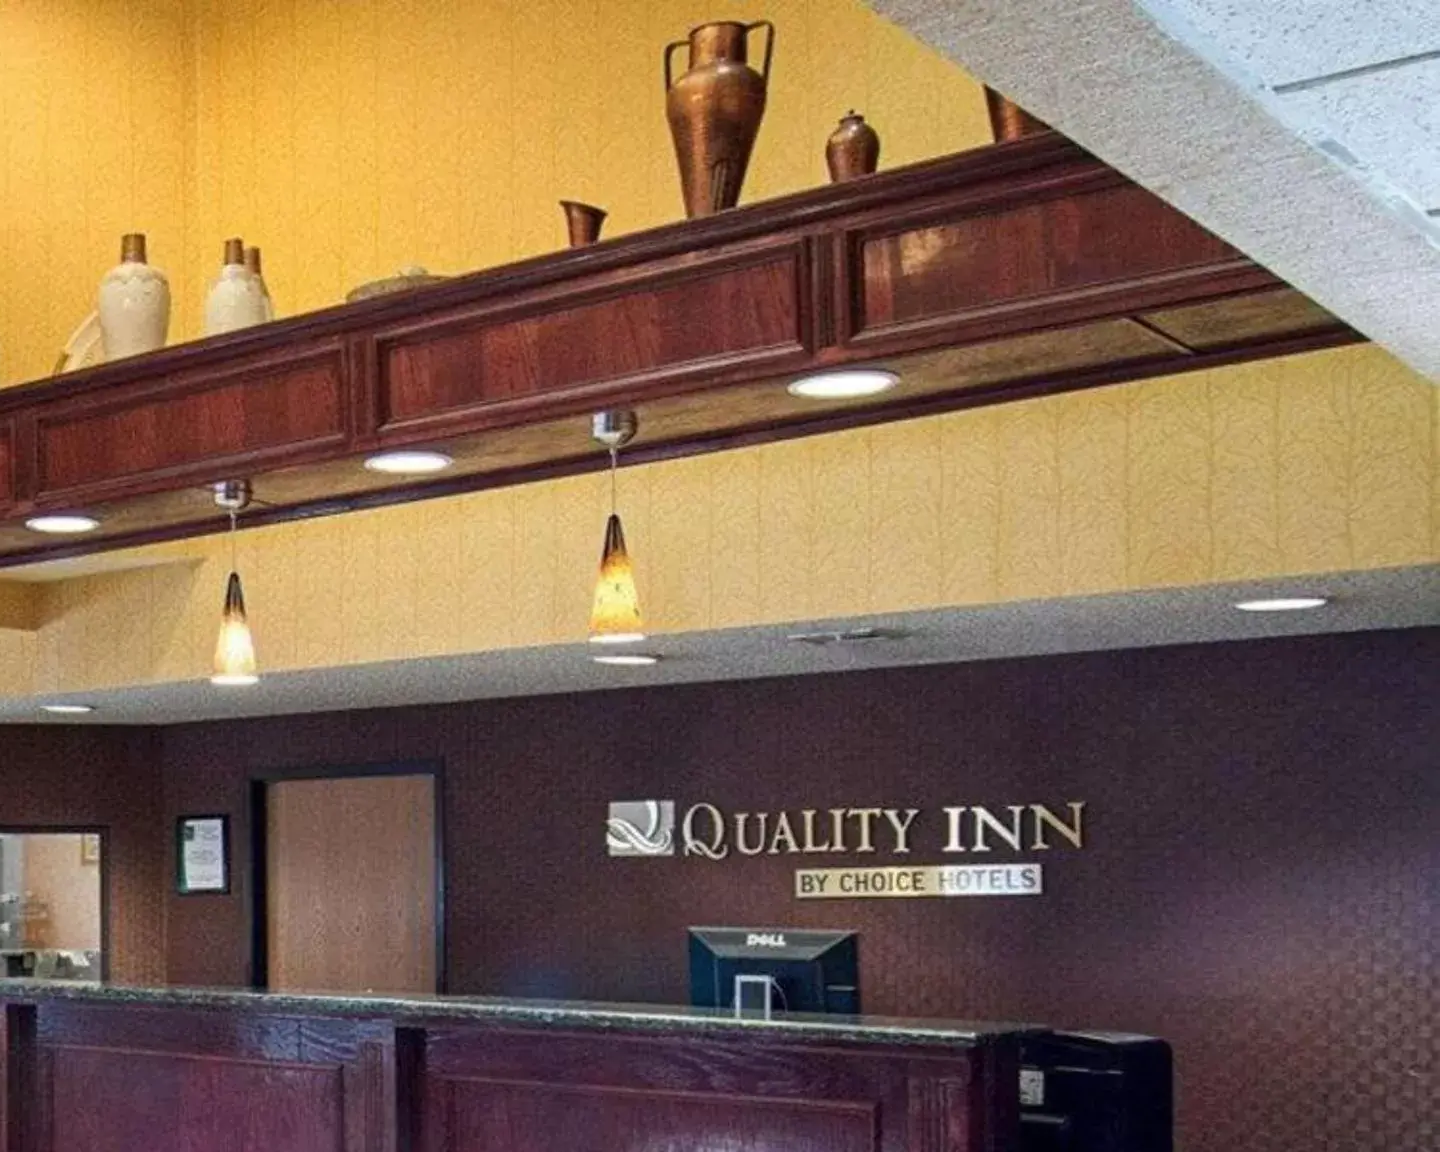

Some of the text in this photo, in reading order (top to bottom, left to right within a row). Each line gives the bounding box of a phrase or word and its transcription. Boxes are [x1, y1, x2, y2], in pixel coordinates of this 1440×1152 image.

[682, 800, 1087, 860] QUALITY INN
[800, 868, 1036, 893] BY CHOICE HOTELS
[747, 933, 786, 947] DELL
